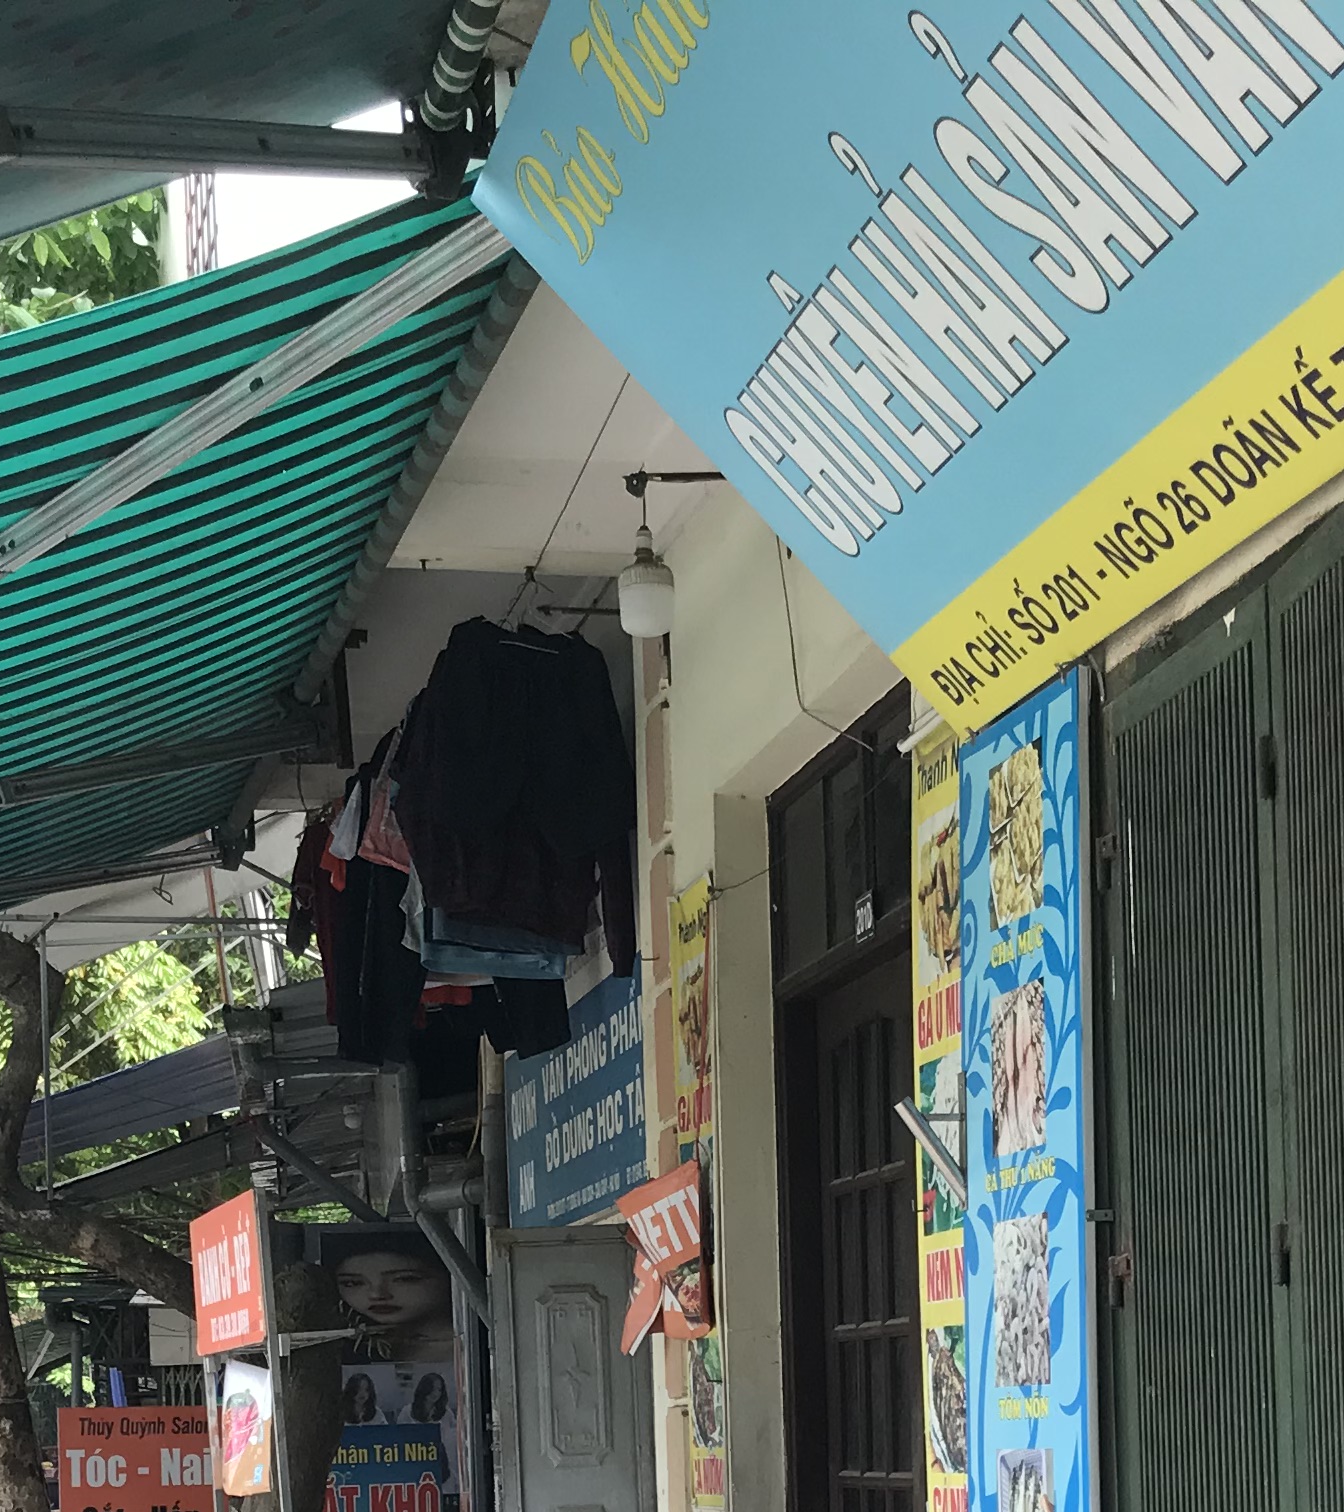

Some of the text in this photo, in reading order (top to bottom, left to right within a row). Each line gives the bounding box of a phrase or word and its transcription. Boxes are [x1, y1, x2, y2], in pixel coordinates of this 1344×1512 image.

[515, 126, 623, 266] Bảo
[907, 9, 1199, 314] SẢN
[828, 131, 1071, 413] HẢI
[930, 641, 982, 707] ĐỊA
[965, 611, 1027, 682] CHỈ:
[1006, 578, 1055, 647] SỐ
[1047, 565, 1101, 621] 201
[1094, 497, 1174, 580] NGÕ
[1156, 480, 1212, 537] 26
[1188, 415, 1303, 508] DOÃN
[541, 1049, 566, 1105] VĂN
[566, 1021, 607, 1080] PHÒNG
[545, 1111, 560, 1173] ĐỒ
[562, 1104, 594, 1166] DÙNG
[597, 1093, 624, 1152] HỌC
[626, 1067, 646, 1137] TẬ
[518, 1159, 537, 1214] ANH
[65, 1447, 128, 1488] Tóc
[159, 1446, 214, 1487] Nai
[332, 1441, 438, 1468] hận Tại Nhà
